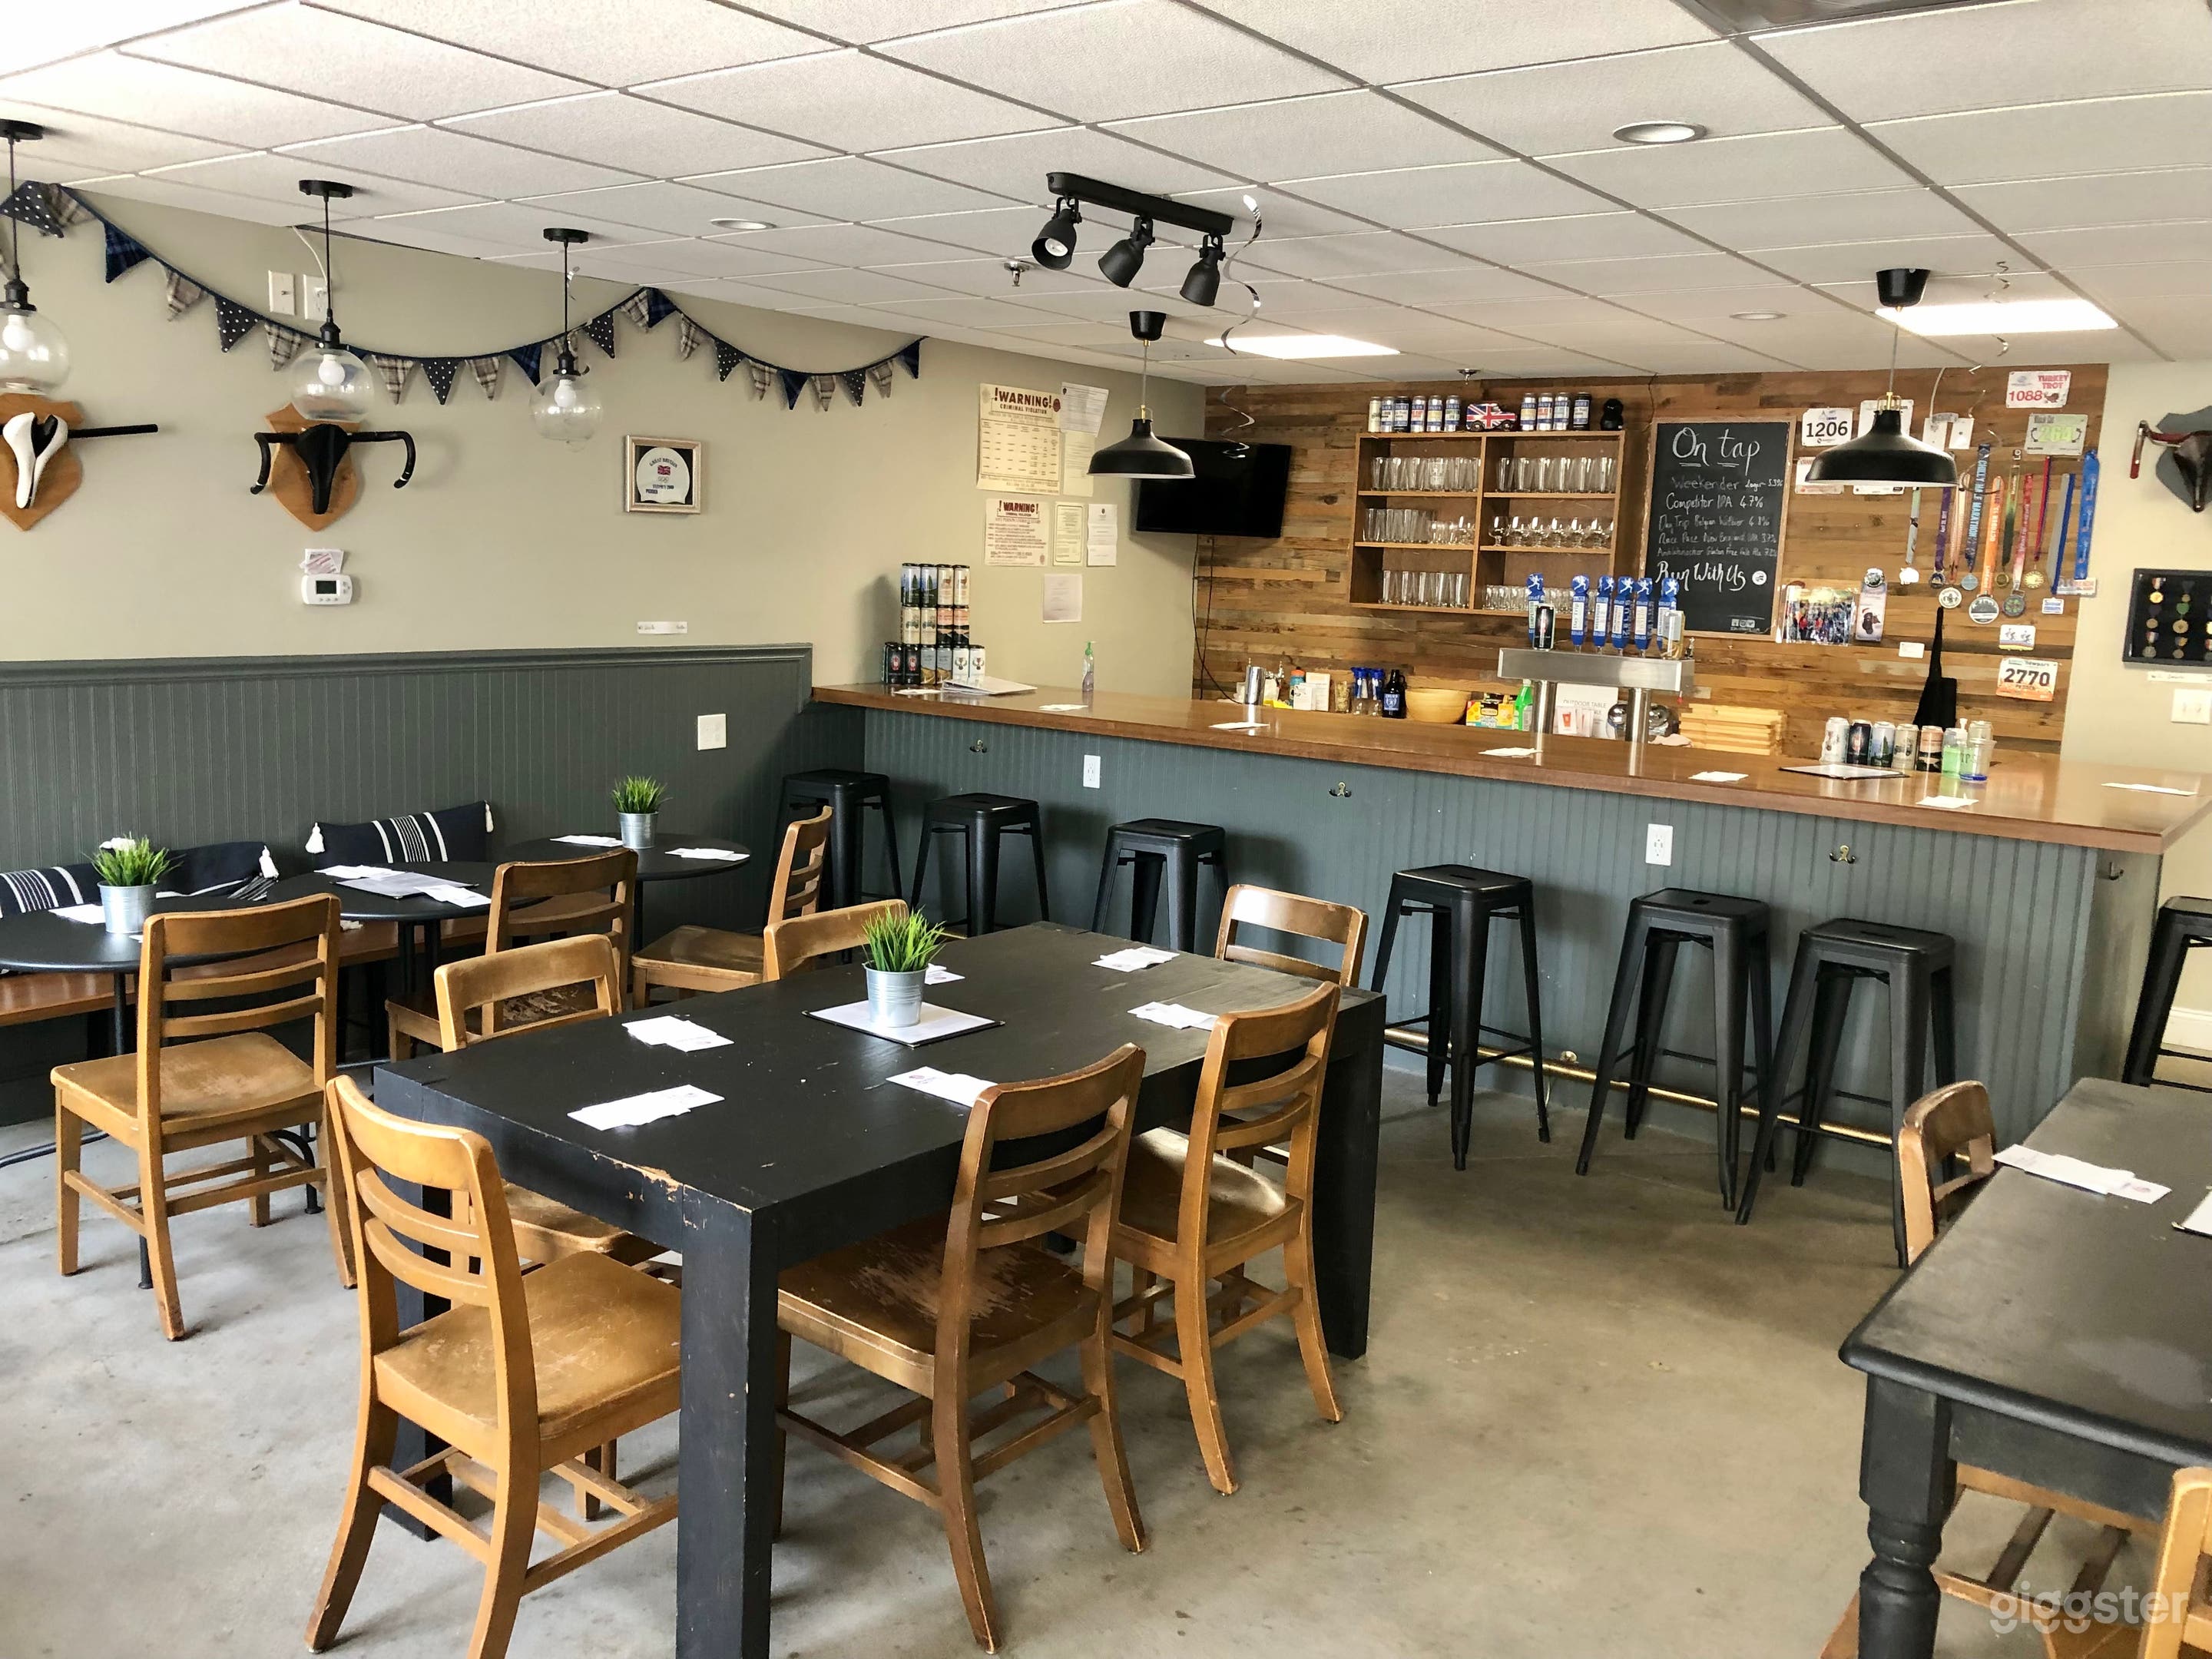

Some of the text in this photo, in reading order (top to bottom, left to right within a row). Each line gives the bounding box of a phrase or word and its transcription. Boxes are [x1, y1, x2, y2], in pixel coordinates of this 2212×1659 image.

[2008, 389, 2043, 402] 1088
[999, 403, 1024, 412] CRIMINAL
[1806, 421, 1849, 438] 1206
[2038, 425, 2072, 442] 264
[1672, 427, 1760, 476] On tap
[1976, 460, 1988, 482] CHILLY
[1672, 475, 1740, 491] Weekender
[1666, 492, 1714, 515] Competitor
[1717, 494, 1733, 509] IPA
[1969, 502, 1982, 538] MARATHON
[1989, 515, 1998, 541] OCTOBER
[1694, 562, 1724, 593] With
[1726, 564, 1747, 591] Us
[1622, 599, 1631, 636] ZELUS
[2003, 667, 2051, 687] 2770
